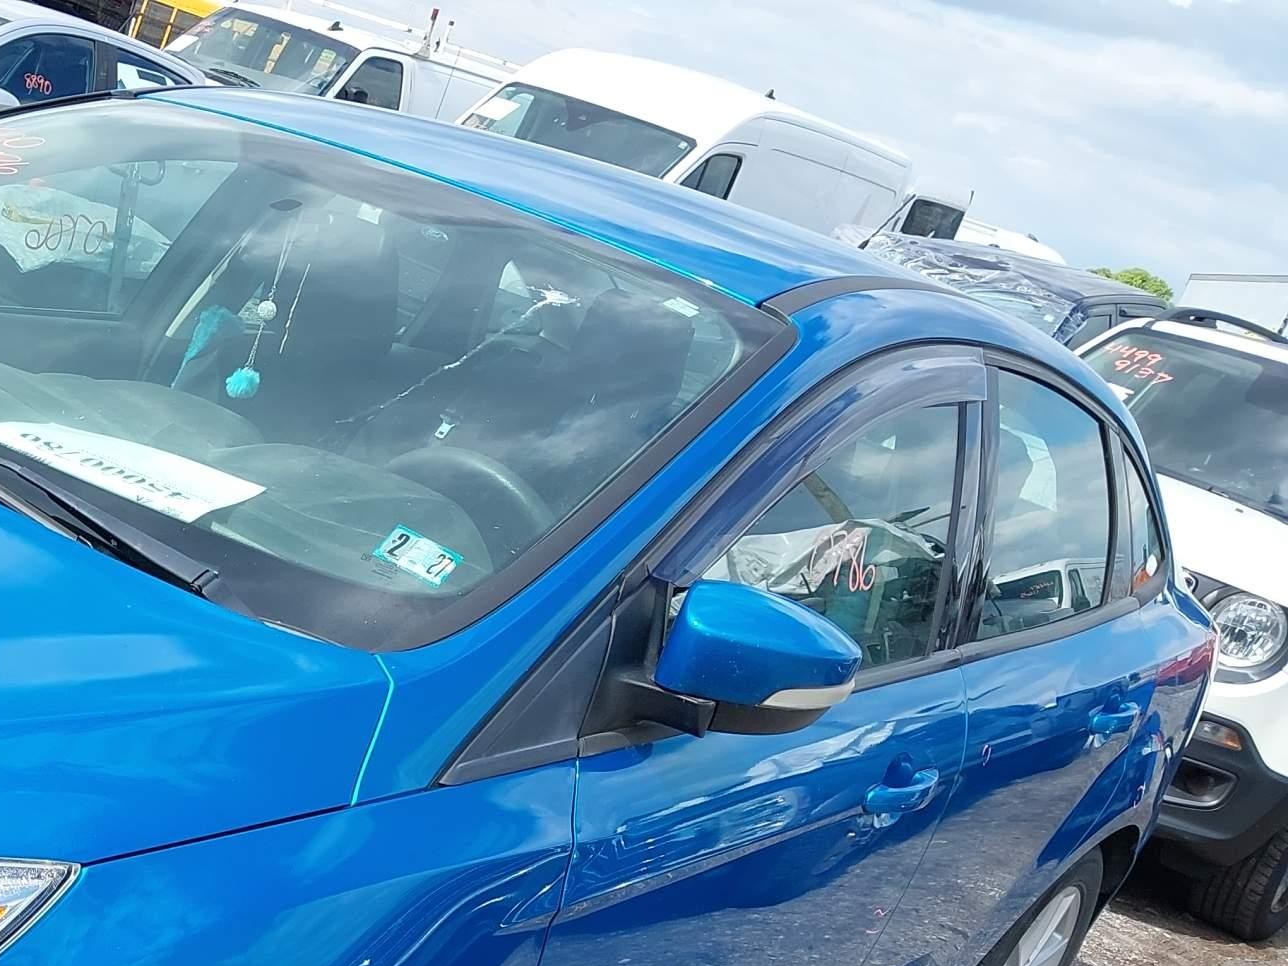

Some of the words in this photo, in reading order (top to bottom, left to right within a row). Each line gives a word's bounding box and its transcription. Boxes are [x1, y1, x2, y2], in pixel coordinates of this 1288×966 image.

[24, 73, 52, 95] 8890
[386, 533, 411, 557] 2
[426, 553, 454, 578] 27
